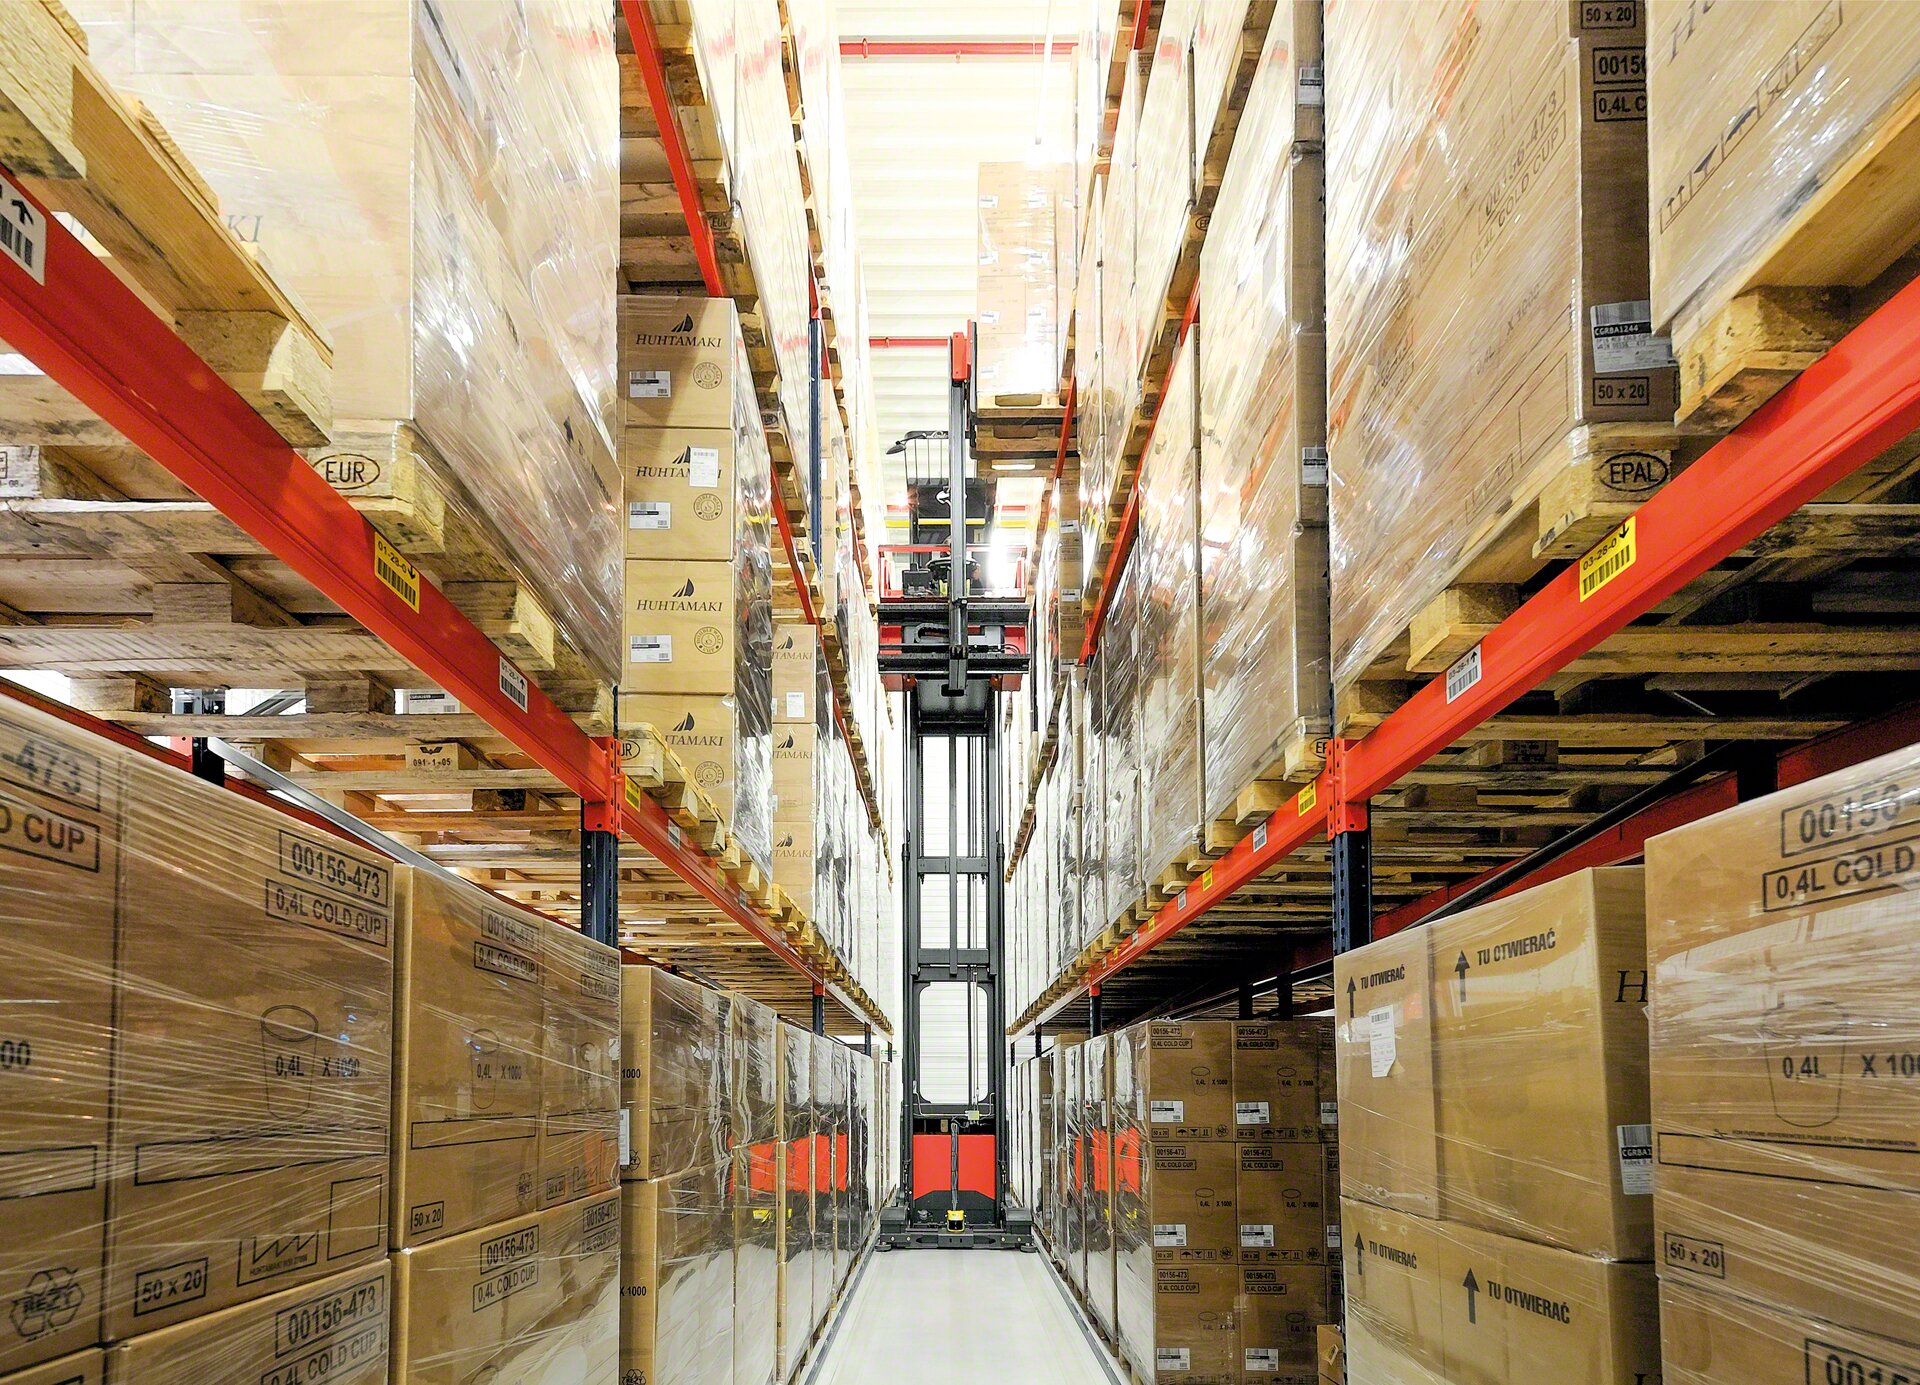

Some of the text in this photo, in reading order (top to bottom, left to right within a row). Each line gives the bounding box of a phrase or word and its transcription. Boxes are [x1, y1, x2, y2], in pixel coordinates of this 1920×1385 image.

[1586, 7, 1632, 21] 50 x 20
[1599, 96, 1631, 115] 0,4L
[1498, 173, 1530, 228] COLD
[1532, 127, 1560, 175] CUP
[635, 334, 722, 348] HUHTAMAKI
[1597, 384, 1645, 399] 50 x 20
[325, 460, 366, 483] EUR
[636, 465, 722, 479] HUHTAI
[1608, 462, 1660, 485] EPAL
[637, 599, 723, 612] HUHTAMAKI
[23, 812, 86, 853] CUP
[291, 842, 381, 899] 00156-473
[1776, 845, 1915, 901] 0,4L COLD
[275, 888, 382, 938] 0,4L COLD CUP
[1477, 928, 1557, 967] TU OTWIERAĆ
[1360, 962, 1406, 991] TU OTWIERAĆ
[276, 1056, 305, 1077] 0,4L
[322, 1057, 333, 1078] X
[622, 1068, 641, 1079] 1000
[1783, 1057, 1827, 1079] 0,4L
[1861, 1055, 1879, 1078] X
[413, 1211, 424, 1227] 50
[432, 1208, 442, 1223] 20
[486, 1231, 536, 1266] 00156-473
[1369, 1240, 1418, 1270] TU OTWIERAĆ
[1670, 1242, 1719, 1269] 50 x 20
[142, 1268, 202, 1303] 50 x 20
[497, 1275, 519, 1296] COLD
[520, 1265, 536, 1282] CUP
[627, 1286, 647, 1297] 1000
[287, 1285, 377, 1345] 00156-473
[1487, 1280, 1571, 1326] TU OTWIERAĆ
[307, 1331, 378, 1381] COLD CUP
